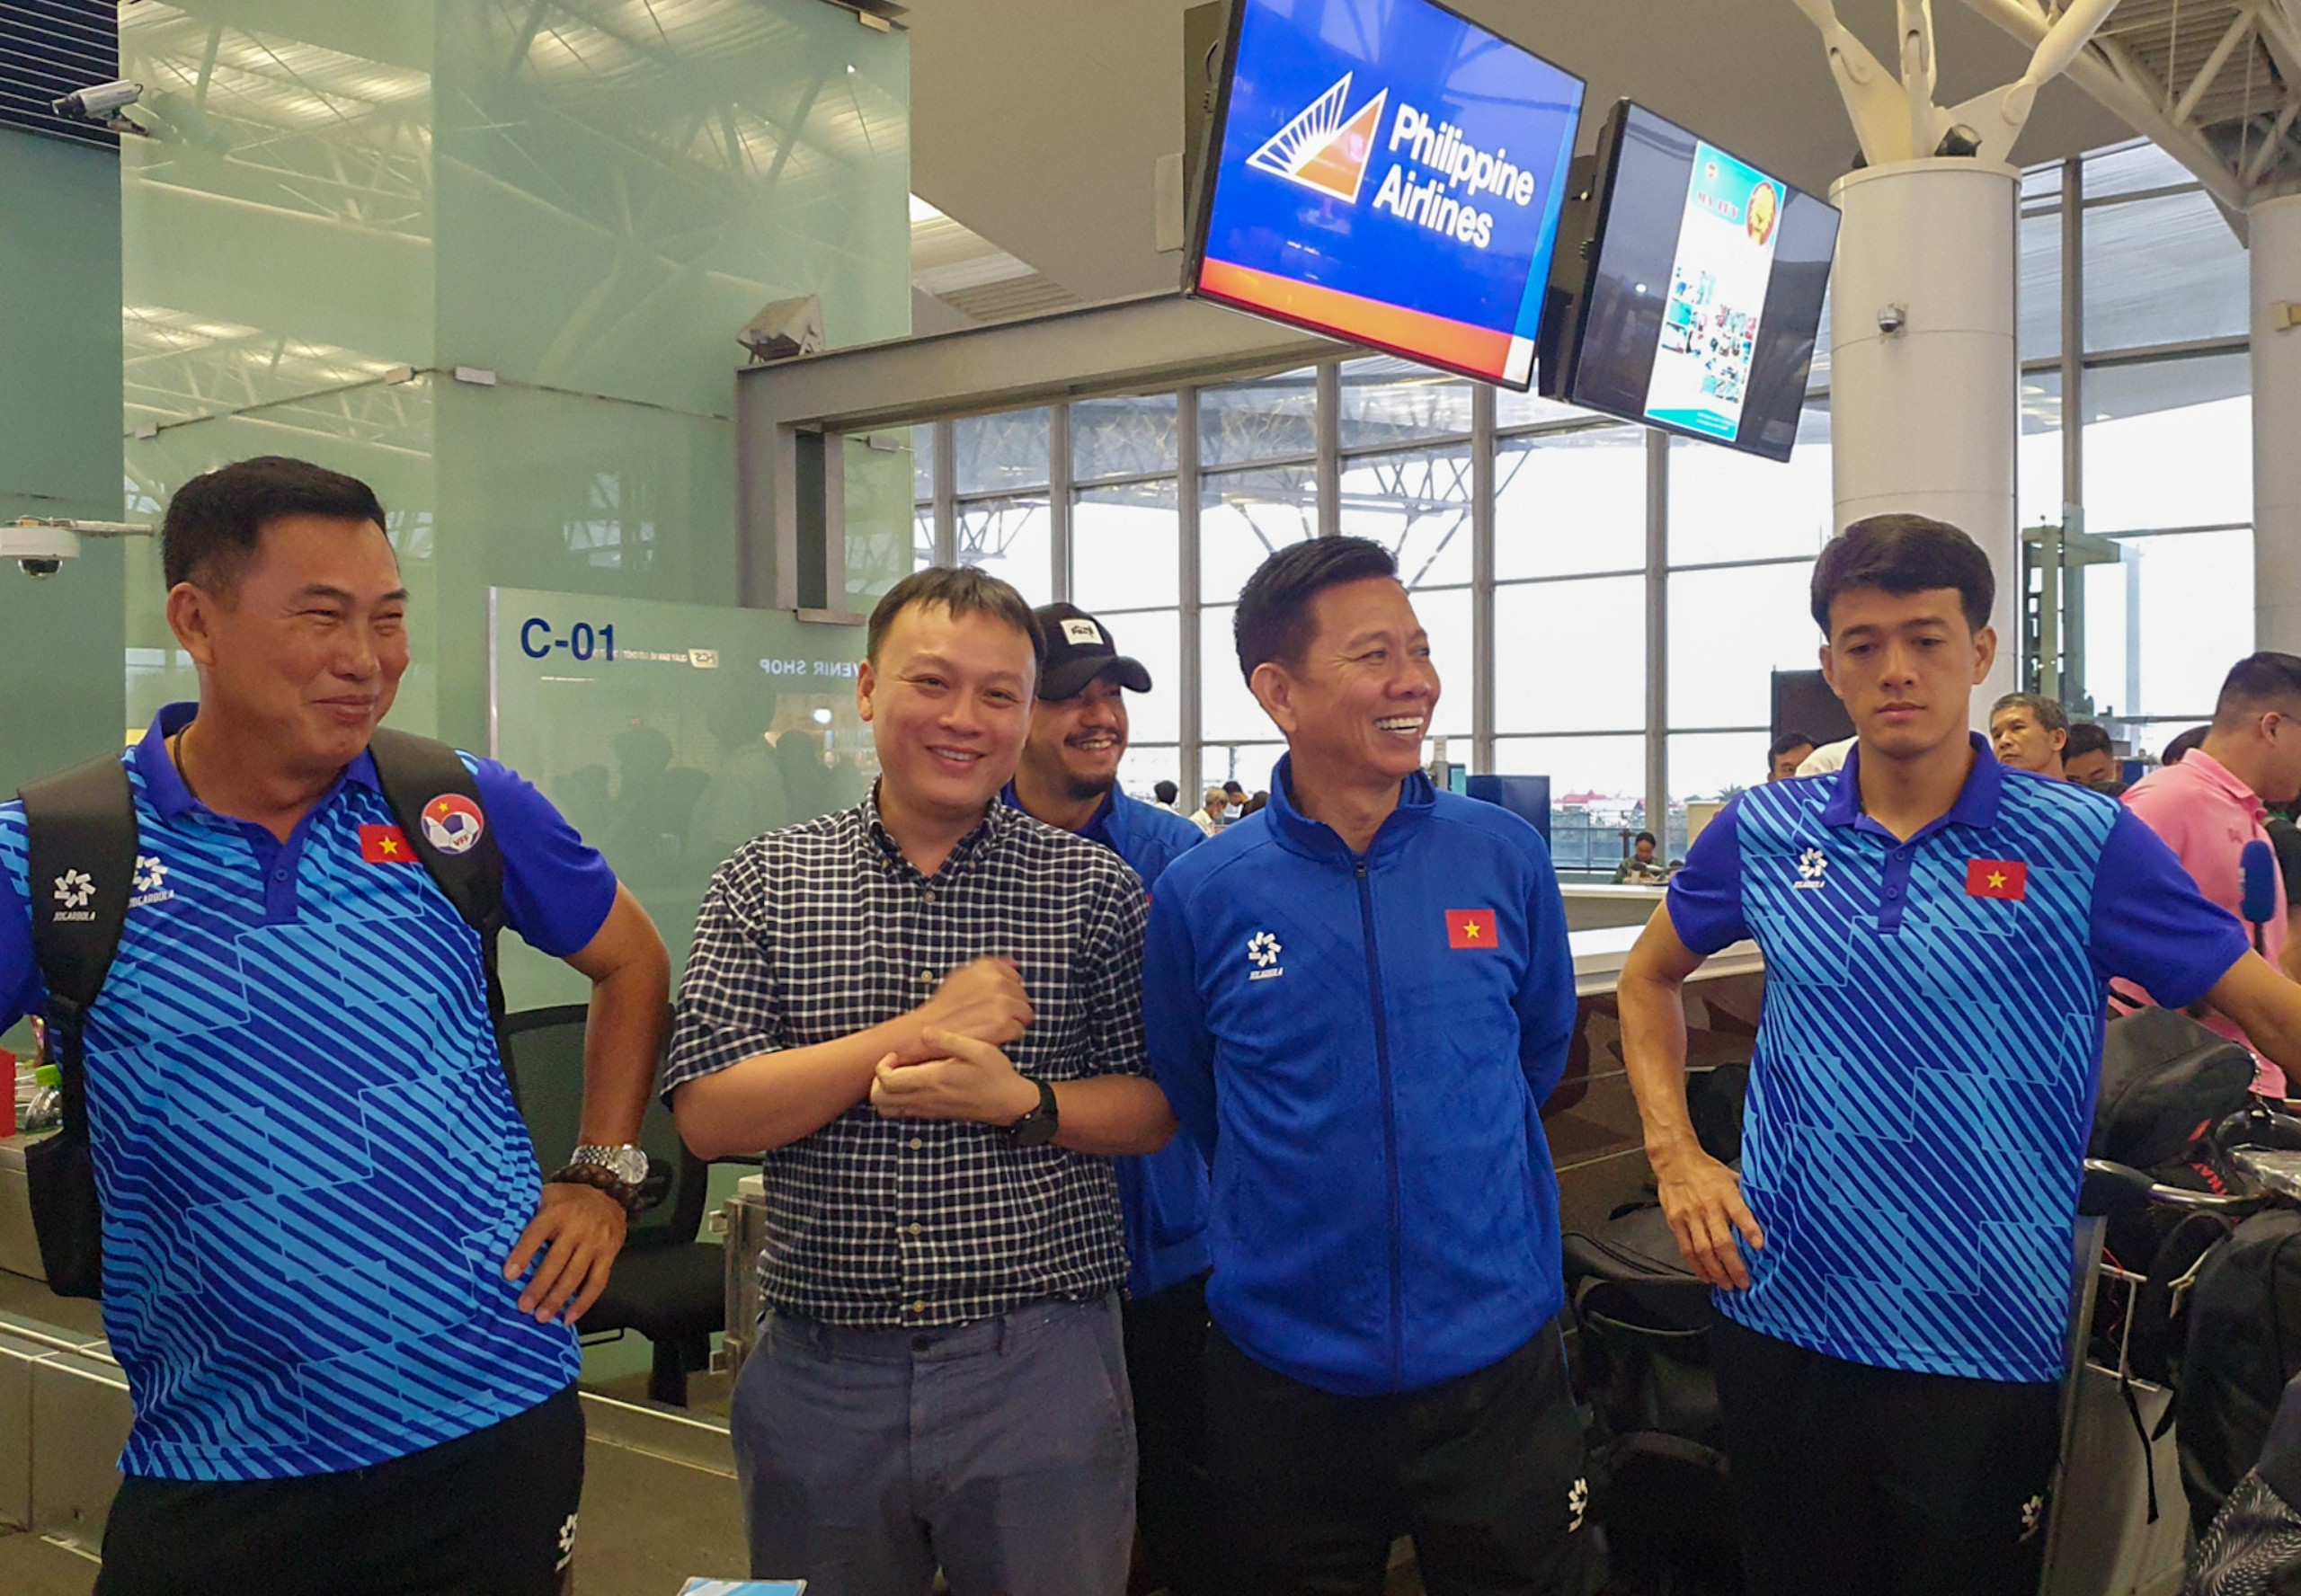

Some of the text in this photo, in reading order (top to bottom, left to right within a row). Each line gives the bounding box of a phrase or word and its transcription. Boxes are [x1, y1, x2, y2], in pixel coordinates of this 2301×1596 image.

[1388, 102, 1535, 206] Philippine
[1372, 163, 1494, 249] Airlines
[520, 617, 615, 662] C-01
[453, 835, 469, 847] VFF
